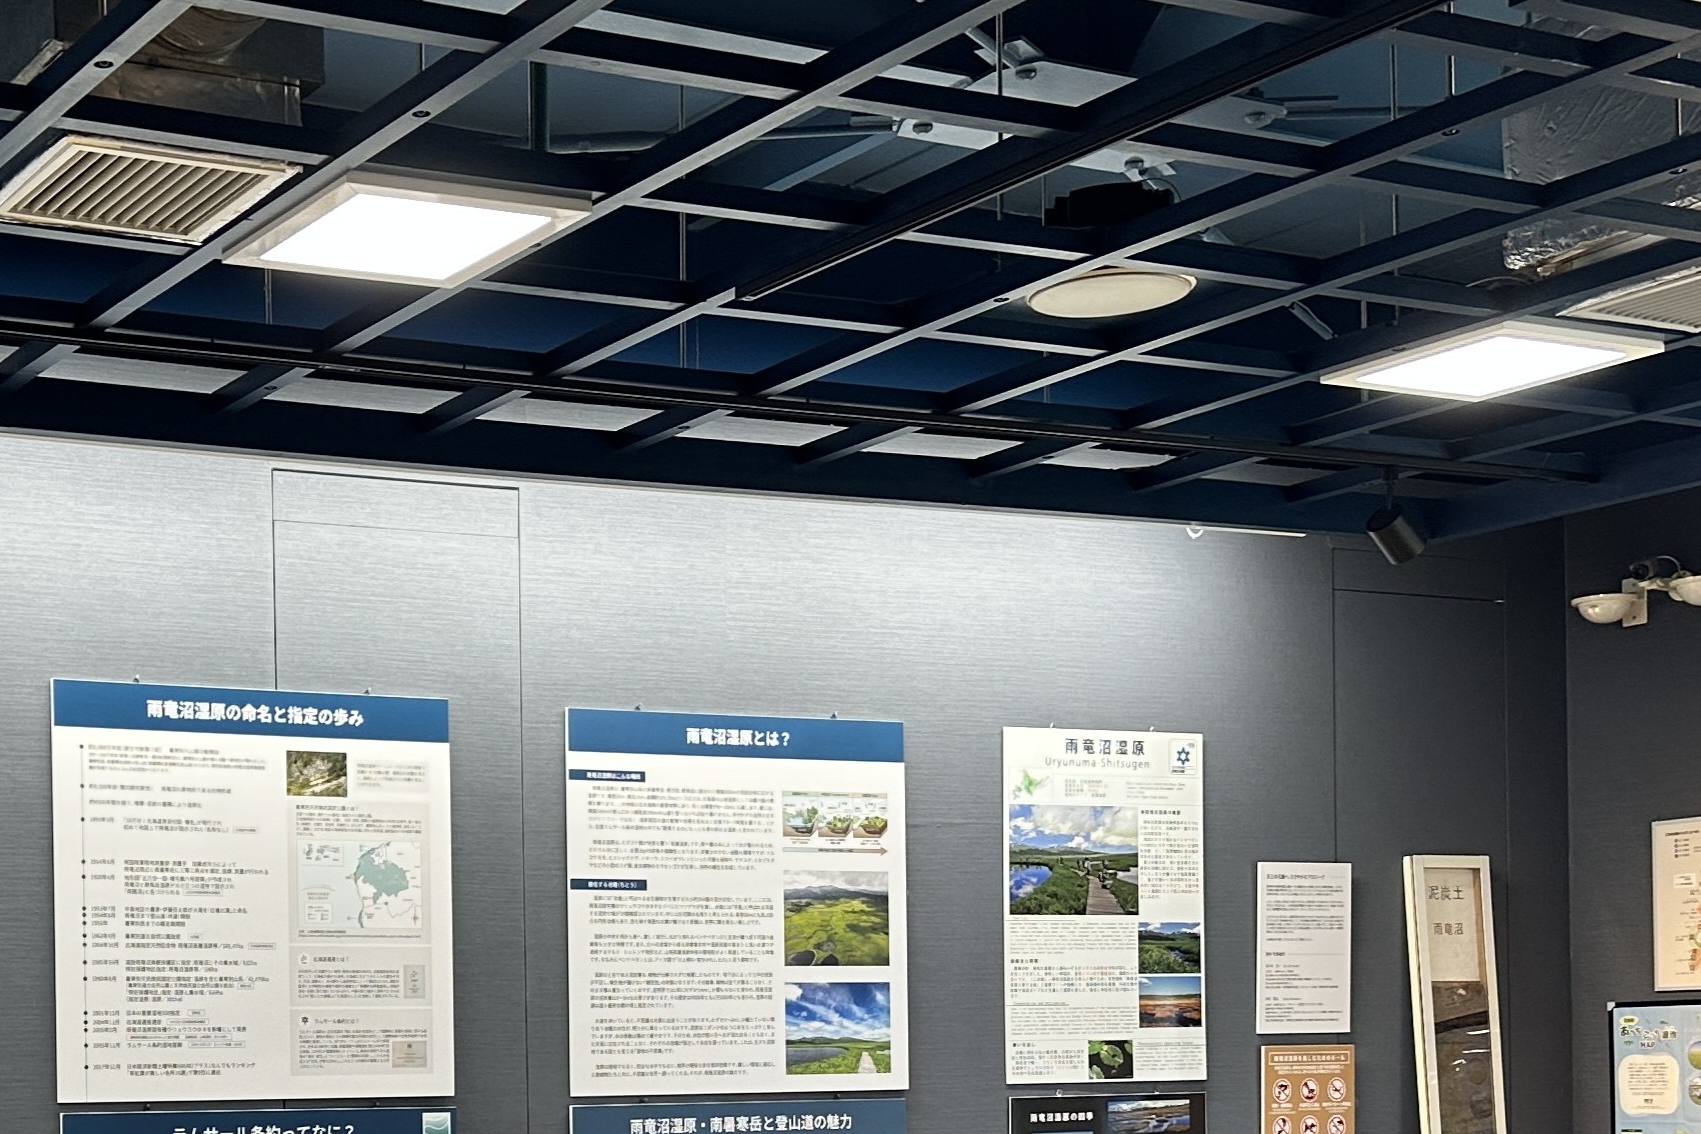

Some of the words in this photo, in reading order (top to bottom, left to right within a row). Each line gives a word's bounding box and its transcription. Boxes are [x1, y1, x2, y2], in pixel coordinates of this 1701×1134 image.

[145, 698, 364, 728] 雨竜沼湿原の命名と指定の歩み
[685, 726, 790, 748] 雨竜沼湿原とは？
[1064, 737, 1145, 756] 雨竜沼湿原
[1428, 885, 1465, 901] 泥炭土
[1433, 922, 1464, 936] 雨竜沼
